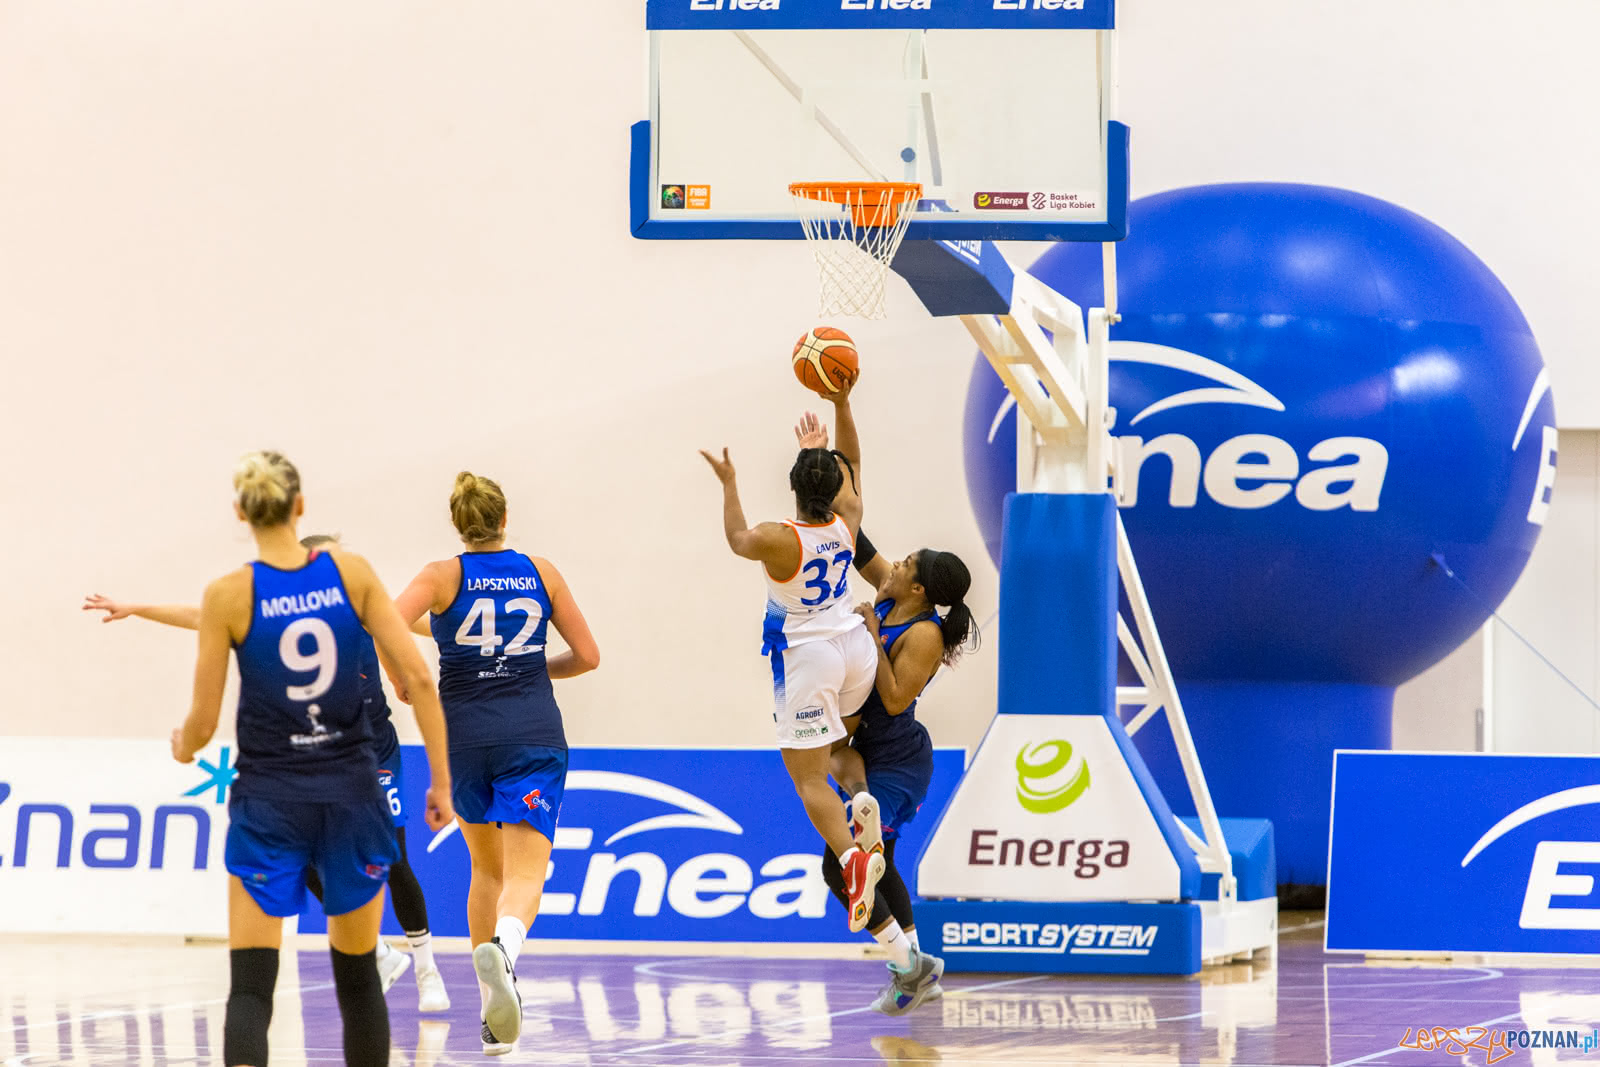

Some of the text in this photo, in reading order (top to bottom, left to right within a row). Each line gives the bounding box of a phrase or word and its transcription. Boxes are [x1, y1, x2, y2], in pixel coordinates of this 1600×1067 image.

[993, 196, 1024, 207] Energa
[1050, 193, 1078, 201] Basket
[1050, 201, 1096, 210] Liga Kobiet
[1117, 432, 1389, 511] nea
[467, 576, 537, 591] LAPSZYNSKI
[801, 549, 853, 606] 32
[260, 586, 344, 618] MOLLOVA
[455, 597, 544, 657] 42
[279, 617, 338, 701] 9
[0, 782, 211, 870] nan
[968, 830, 1130, 879] Energa
[942, 922, 1158, 951] SPORTSYSTEM
